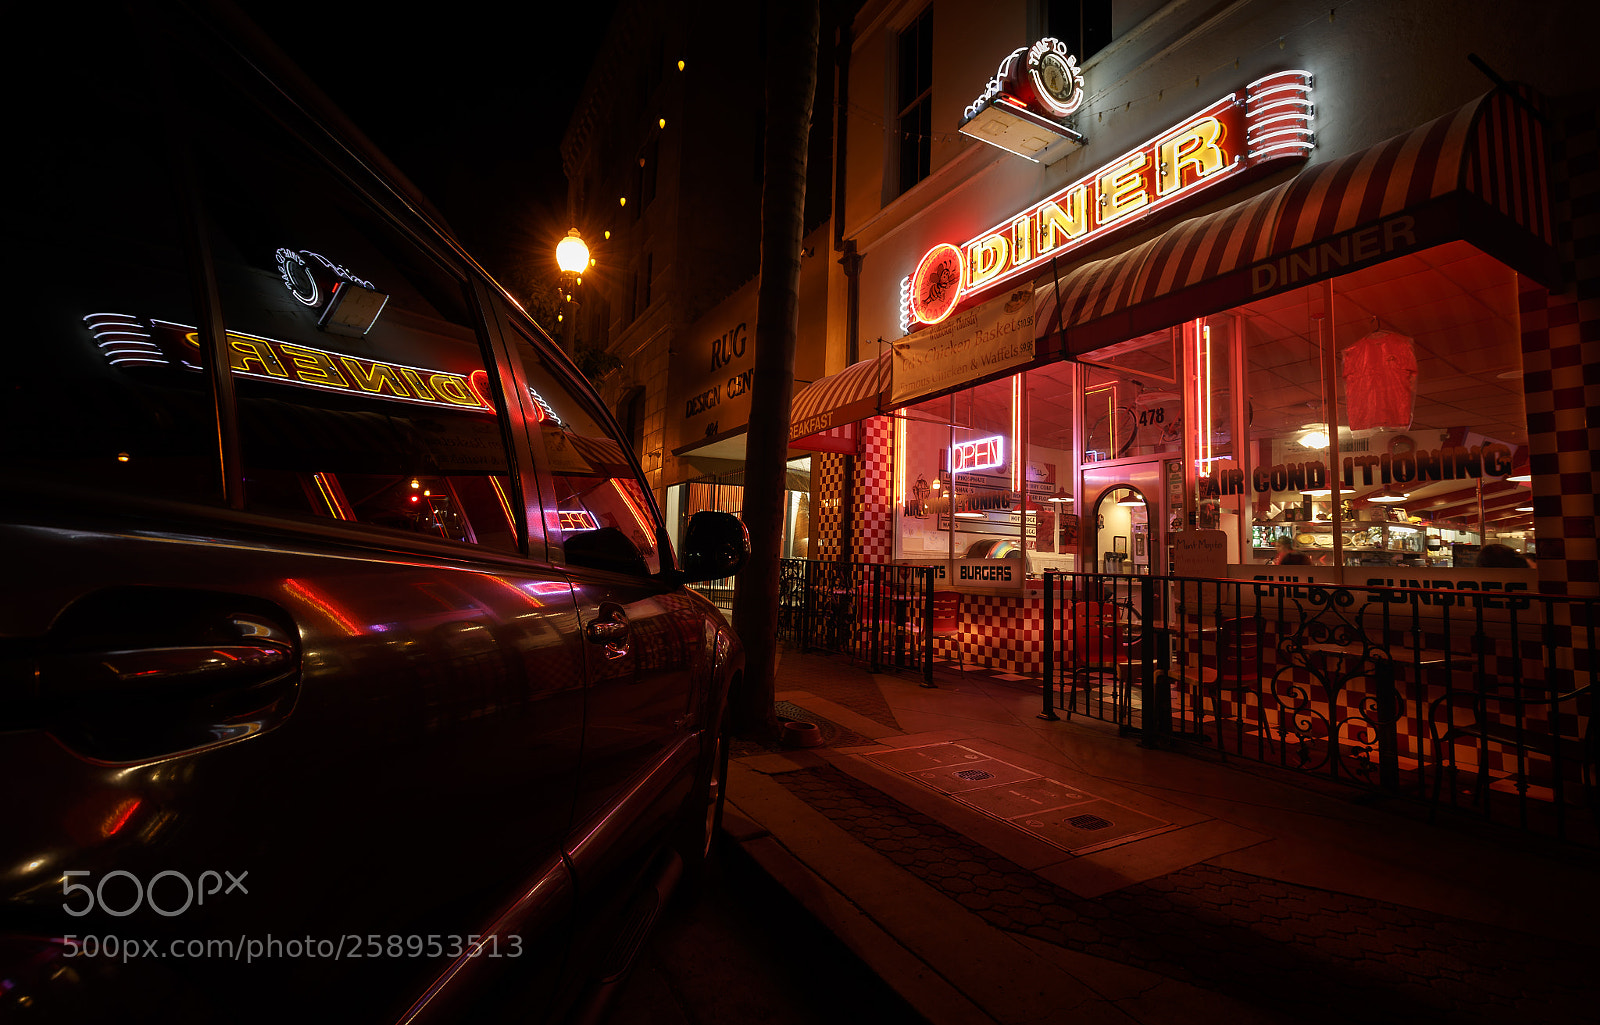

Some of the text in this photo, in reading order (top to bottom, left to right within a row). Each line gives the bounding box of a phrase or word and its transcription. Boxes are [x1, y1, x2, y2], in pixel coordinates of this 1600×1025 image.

[1049, 37, 1067, 55] TO
[967, 115, 1228, 288] DINER
[1251, 215, 1417, 295] DINNER
[711, 323, 747, 372] RUG
[924, 338, 971, 363] Chicken
[975, 319, 1016, 346] Basket
[932, 364, 968, 383] Chicken
[685, 368, 754, 418] DESIGN CEN
[789, 411, 834, 440] REAKFAST
[1139, 407, 1165, 426] 478
[953, 438, 1002, 471] OPEN
[1206, 467, 1244, 496] AIR
[960, 565, 1012, 581] BURGERS
[1367, 578, 1529, 609] SUNDAES
